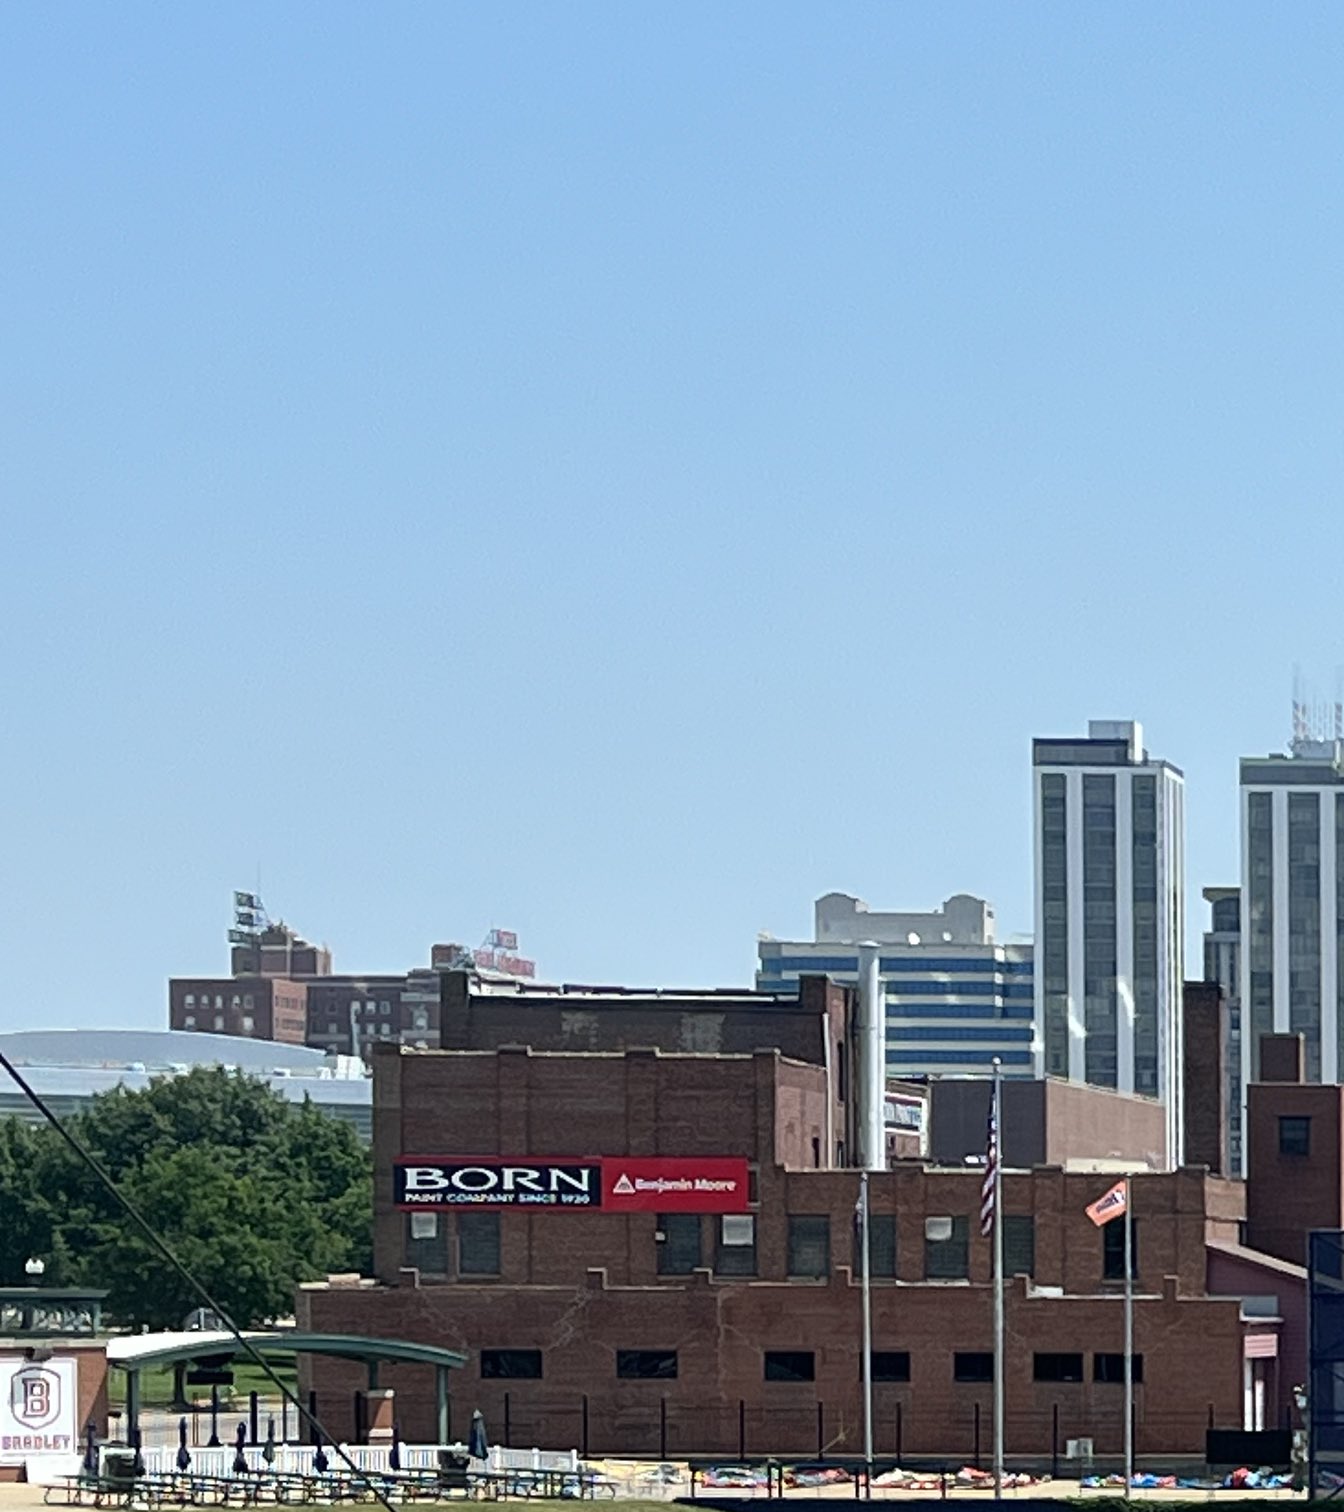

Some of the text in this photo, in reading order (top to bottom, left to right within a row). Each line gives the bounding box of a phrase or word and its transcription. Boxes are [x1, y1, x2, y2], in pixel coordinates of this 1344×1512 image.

[404, 1167, 591, 1191] BORN
[635, 1178, 737, 1194] Benjamin Moore
[405, 1193, 443, 1203] PAINT
[447, 1193, 515, 1203] COMPANY
[519, 1194, 557, 1204] SINCE
[22, 1377, 50, 1418] B
[1, 1434, 71, 1450] BRADLEY
